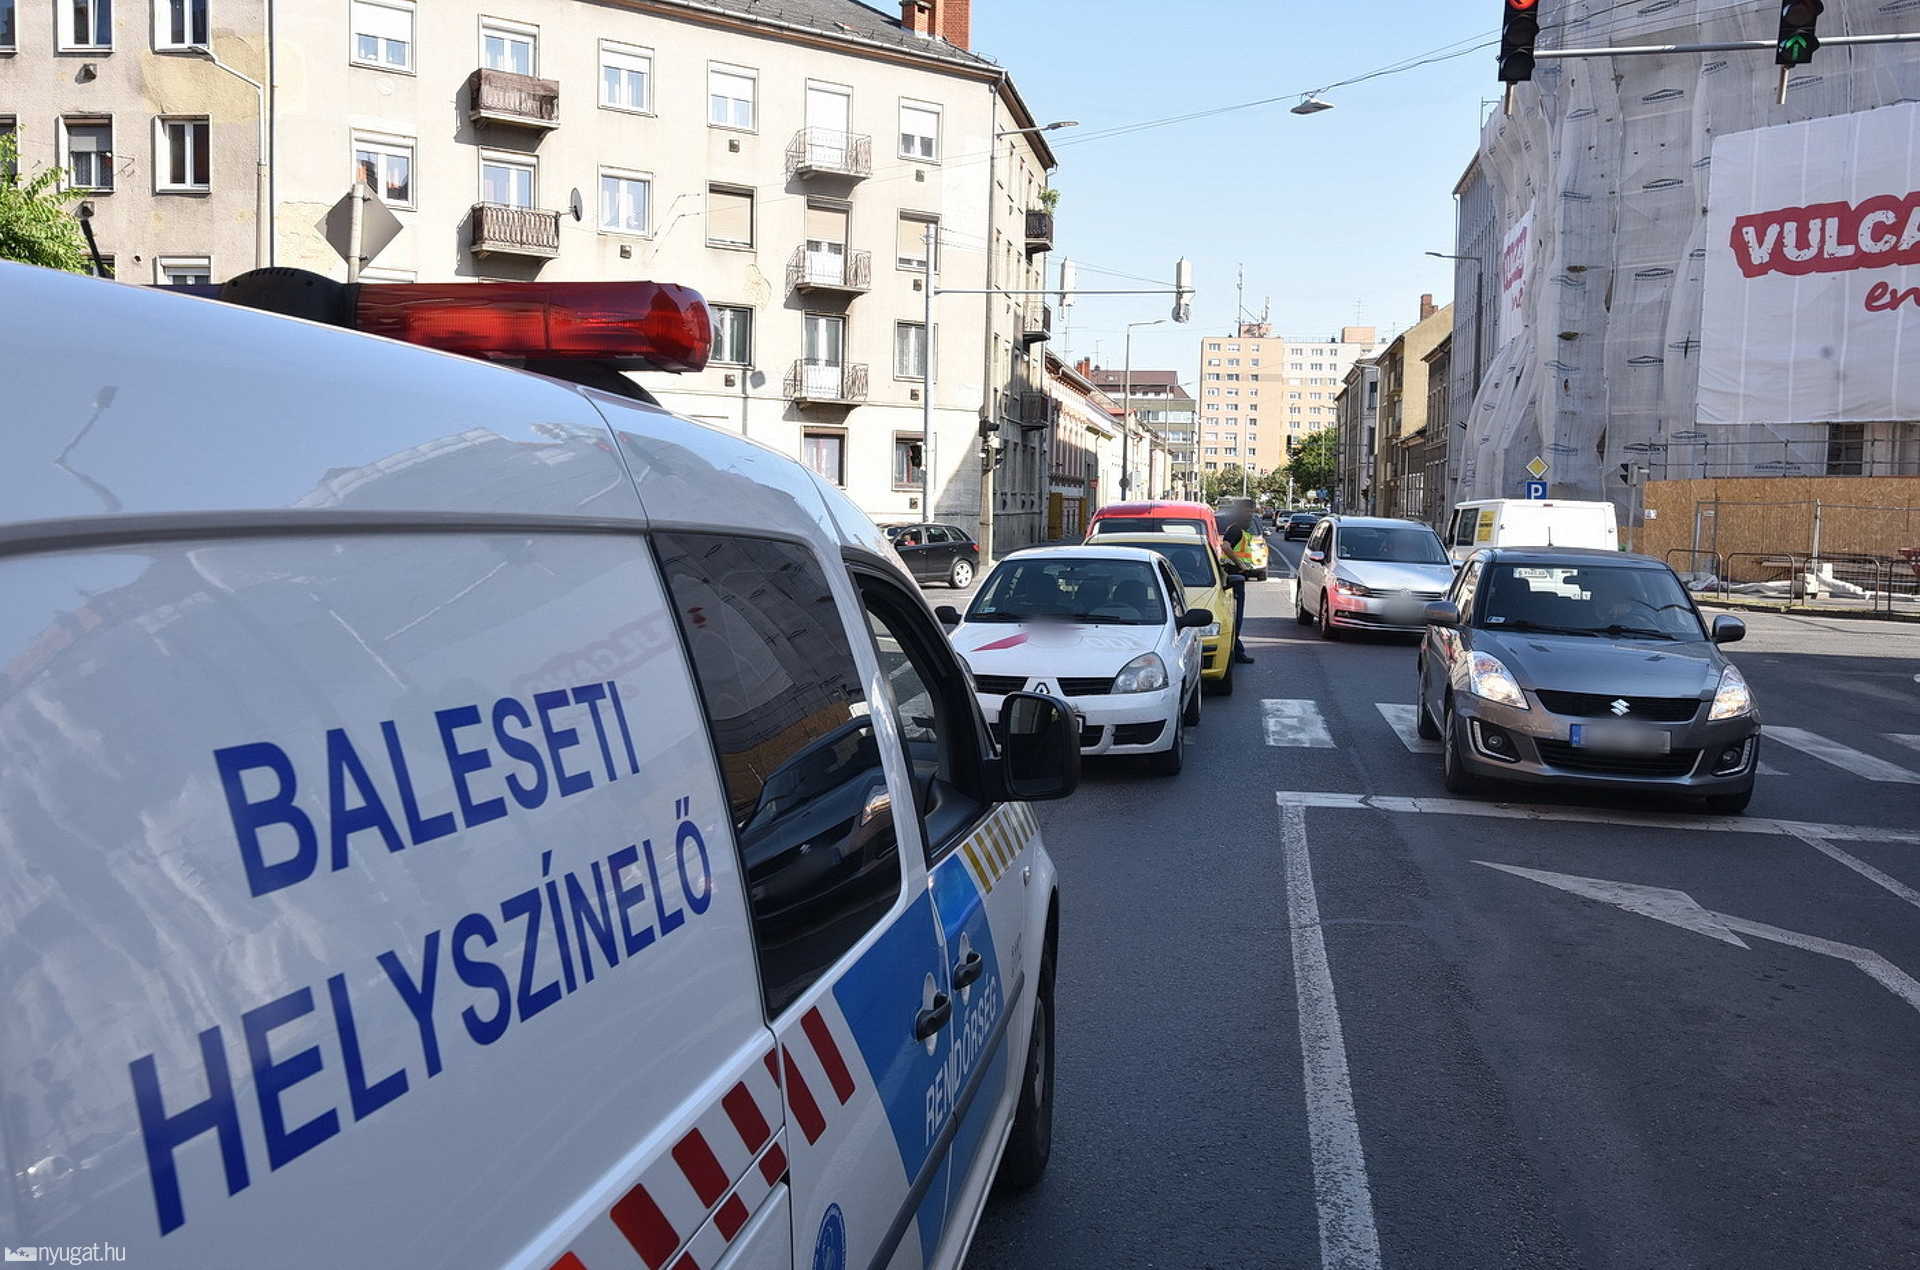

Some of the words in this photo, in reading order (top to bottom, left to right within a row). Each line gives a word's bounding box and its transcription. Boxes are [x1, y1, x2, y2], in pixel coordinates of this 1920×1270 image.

[1530, 484, 1543, 500] P
[214, 681, 640, 897] BALESETI
[129, 796, 711, 1237] HELYSZÍNELŐ
